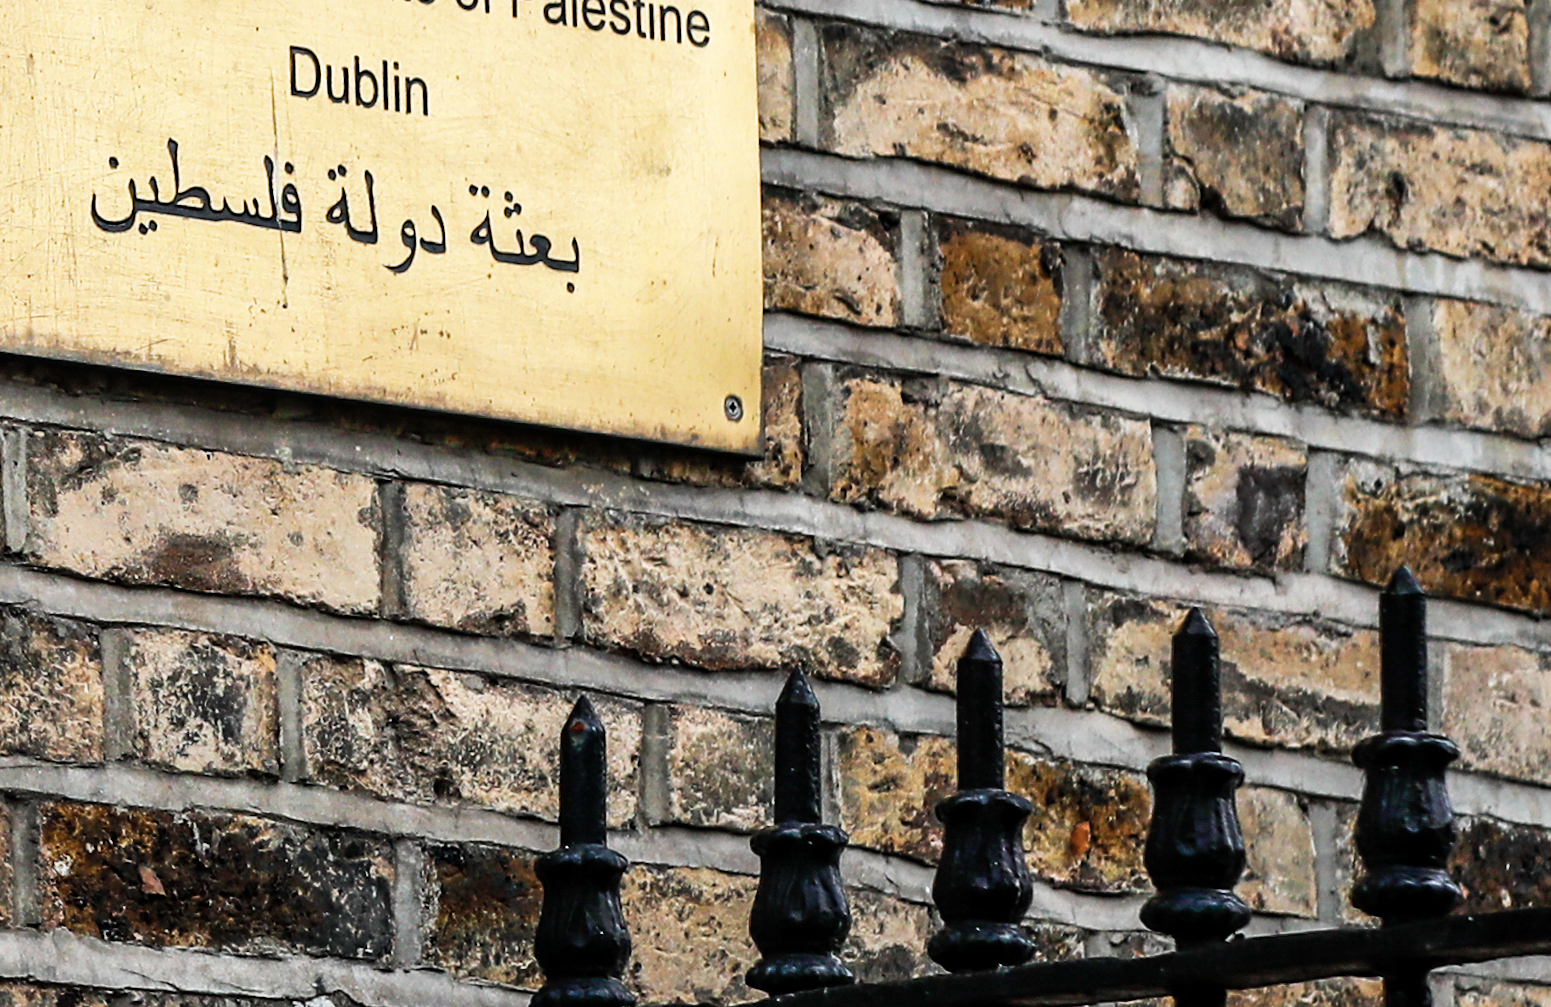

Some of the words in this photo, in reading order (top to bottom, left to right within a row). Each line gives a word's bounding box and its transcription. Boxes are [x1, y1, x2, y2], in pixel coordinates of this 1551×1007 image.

[289, 45, 429, 117] Dublin
[90, 137, 303, 236] فلسطين
[325, 164, 447, 274] دولة
[468, 184, 580, 294] بعثة
